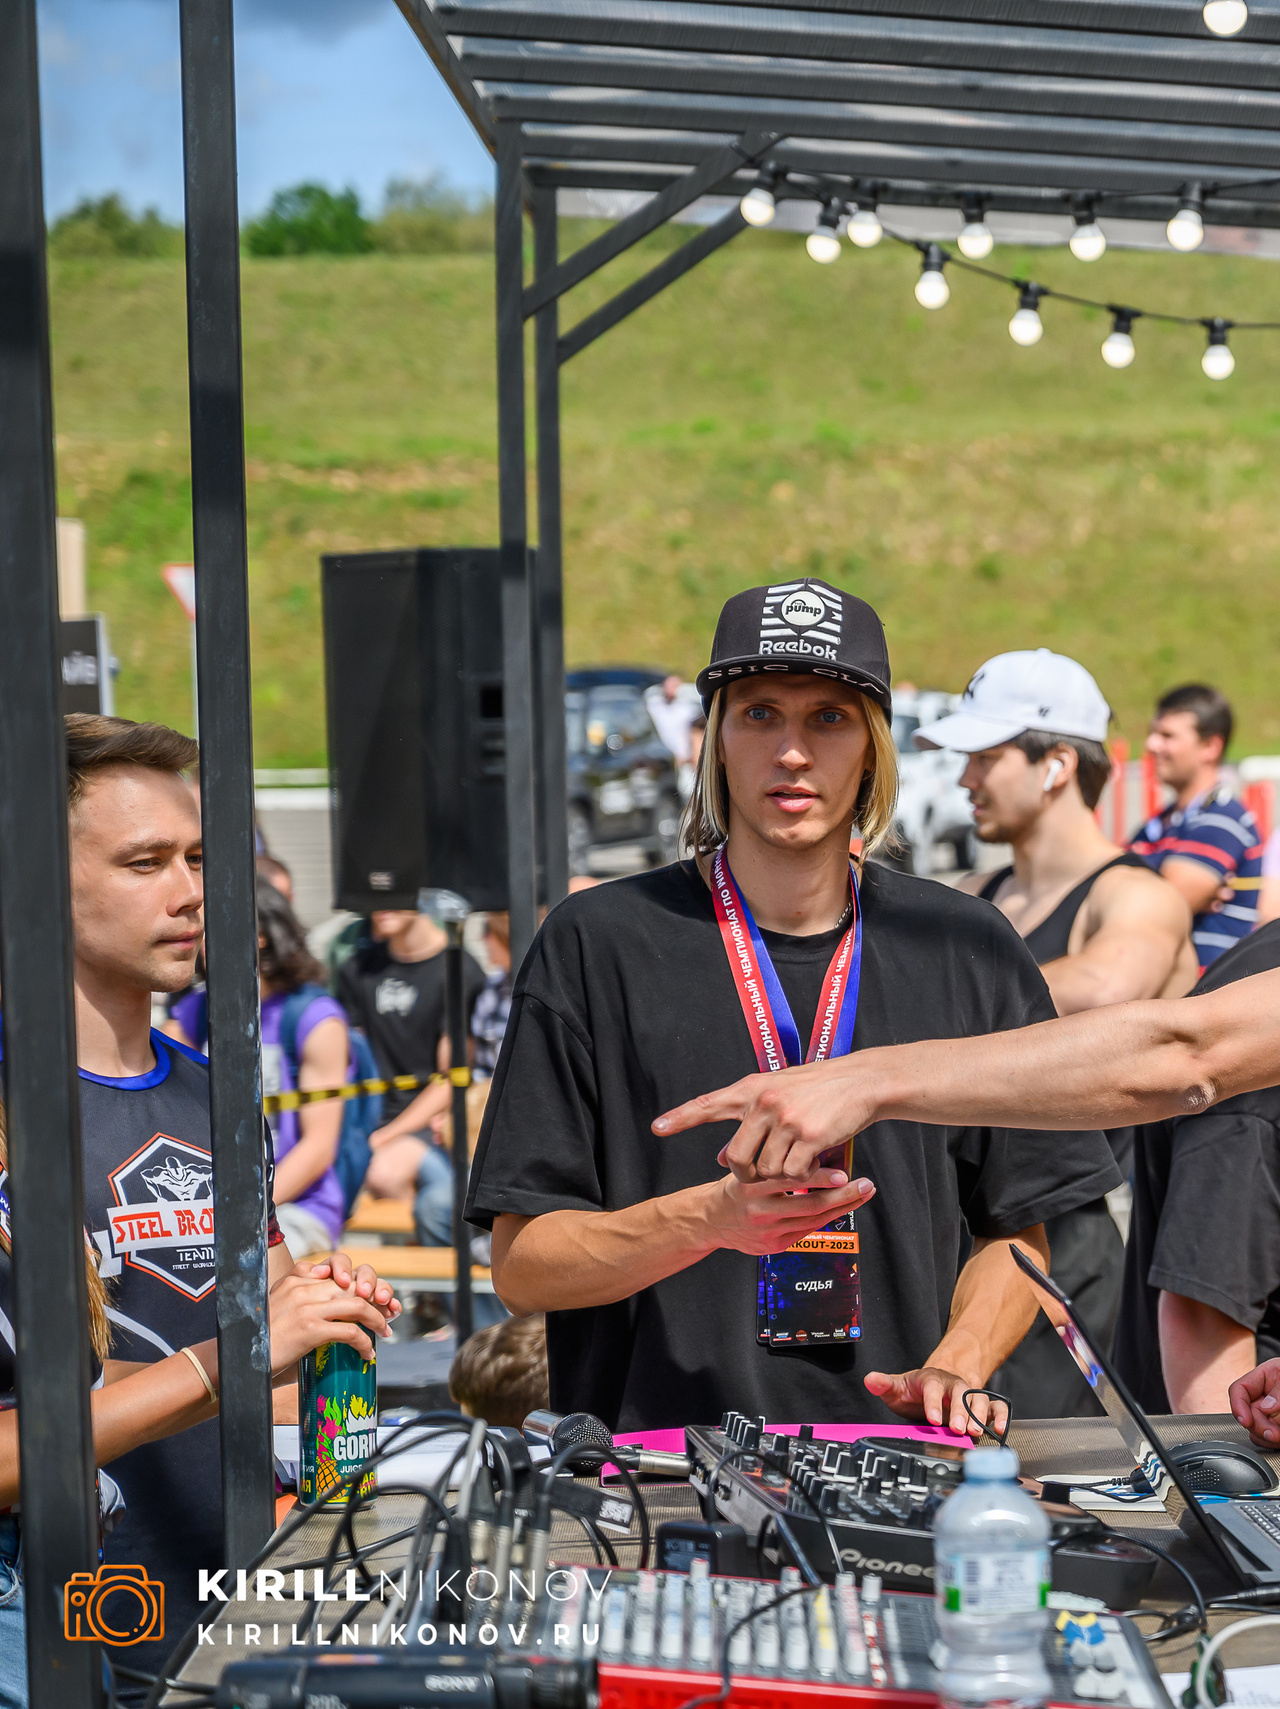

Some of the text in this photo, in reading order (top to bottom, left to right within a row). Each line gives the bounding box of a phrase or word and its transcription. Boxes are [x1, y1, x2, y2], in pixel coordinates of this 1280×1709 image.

[785, 604, 822, 617] pump
[759, 639, 837, 661] Reebok
[708, 664, 884, 694] SSIC CLA
[720, 889, 733, 907] ПО
[725, 906, 753, 978] ЧЕМПИОНАТ
[815, 925, 854, 1062] ЕГИОНАЛЬНЫЙ ЧЕМПИ
[744, 979, 781, 1072] ЕГИОНАЛЬНЫЙ
[112, 1208, 214, 1244] STEEL BRO
[176, 1247, 214, 1261] TEAM
[789, 1240, 855, 1250] KOUT-2023
[795, 1280, 833, 1292] СУДЬЯ
